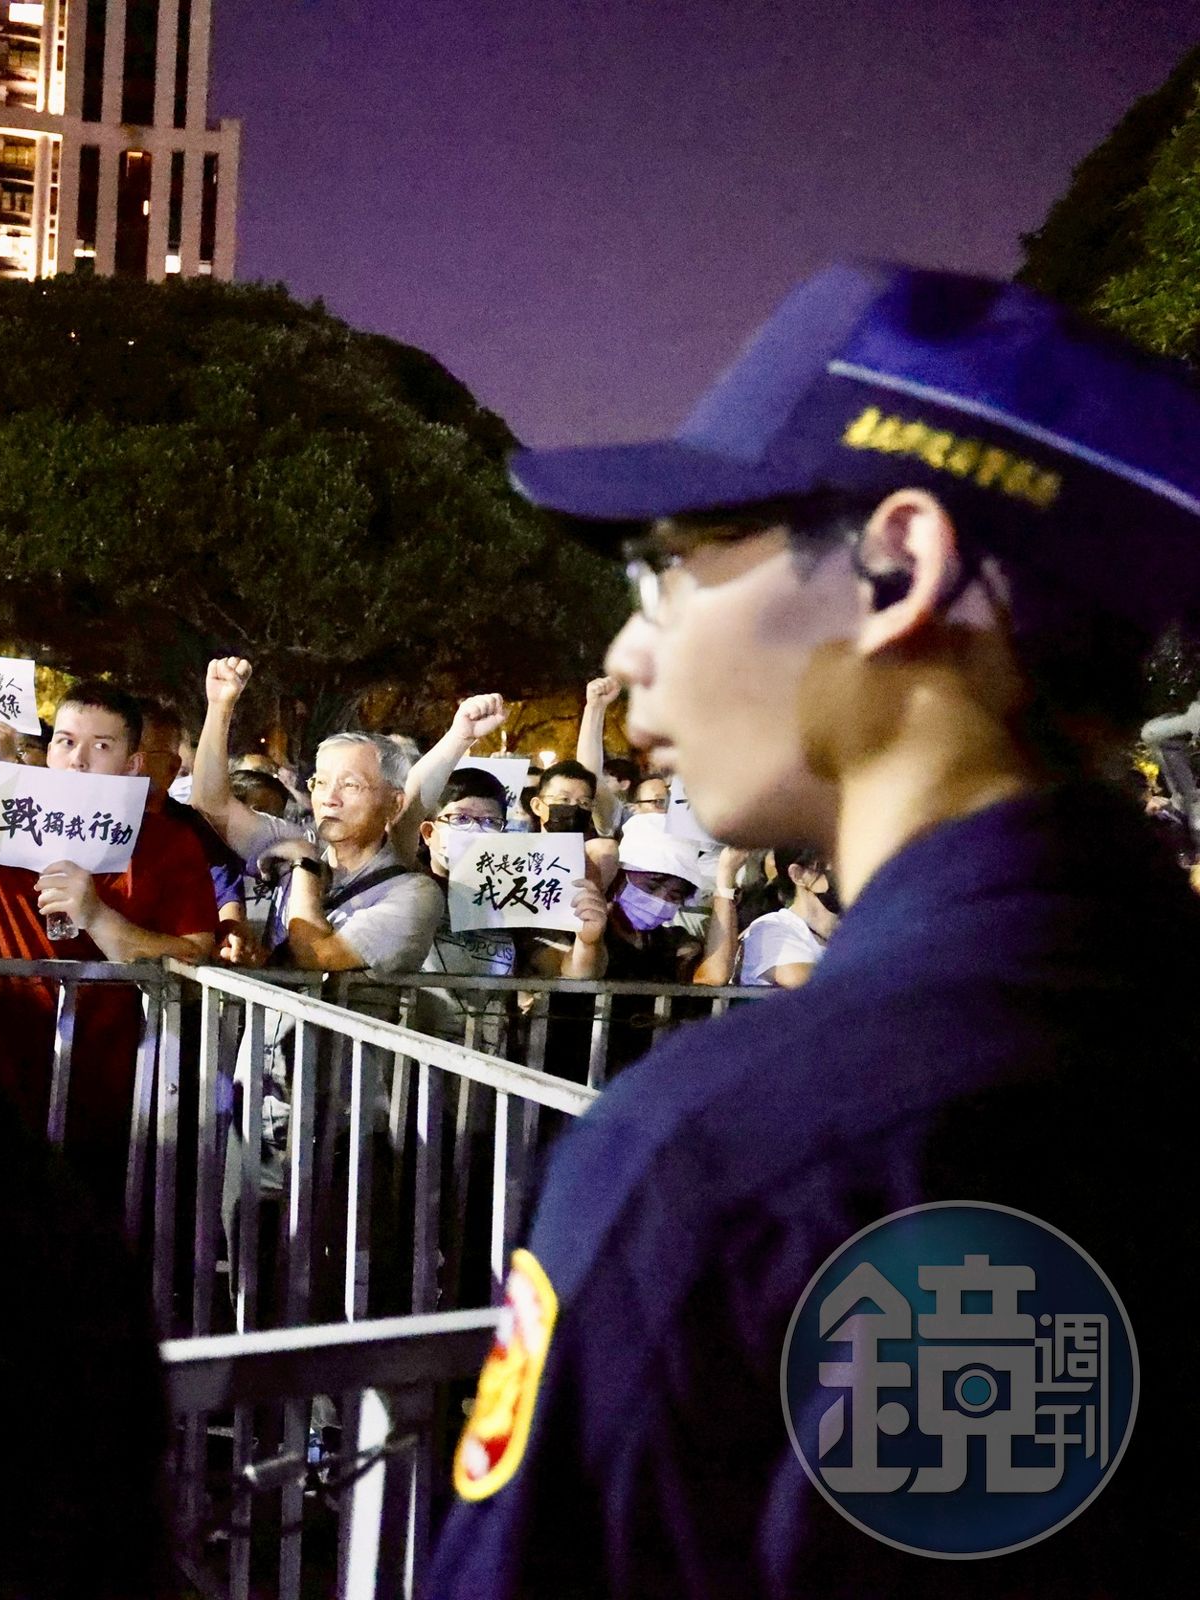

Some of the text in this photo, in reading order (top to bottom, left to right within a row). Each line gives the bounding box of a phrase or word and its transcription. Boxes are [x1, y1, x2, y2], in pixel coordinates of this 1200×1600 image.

[475, 851, 571, 876] 我是台灣人
[472, 875, 563, 914] 我反綠
